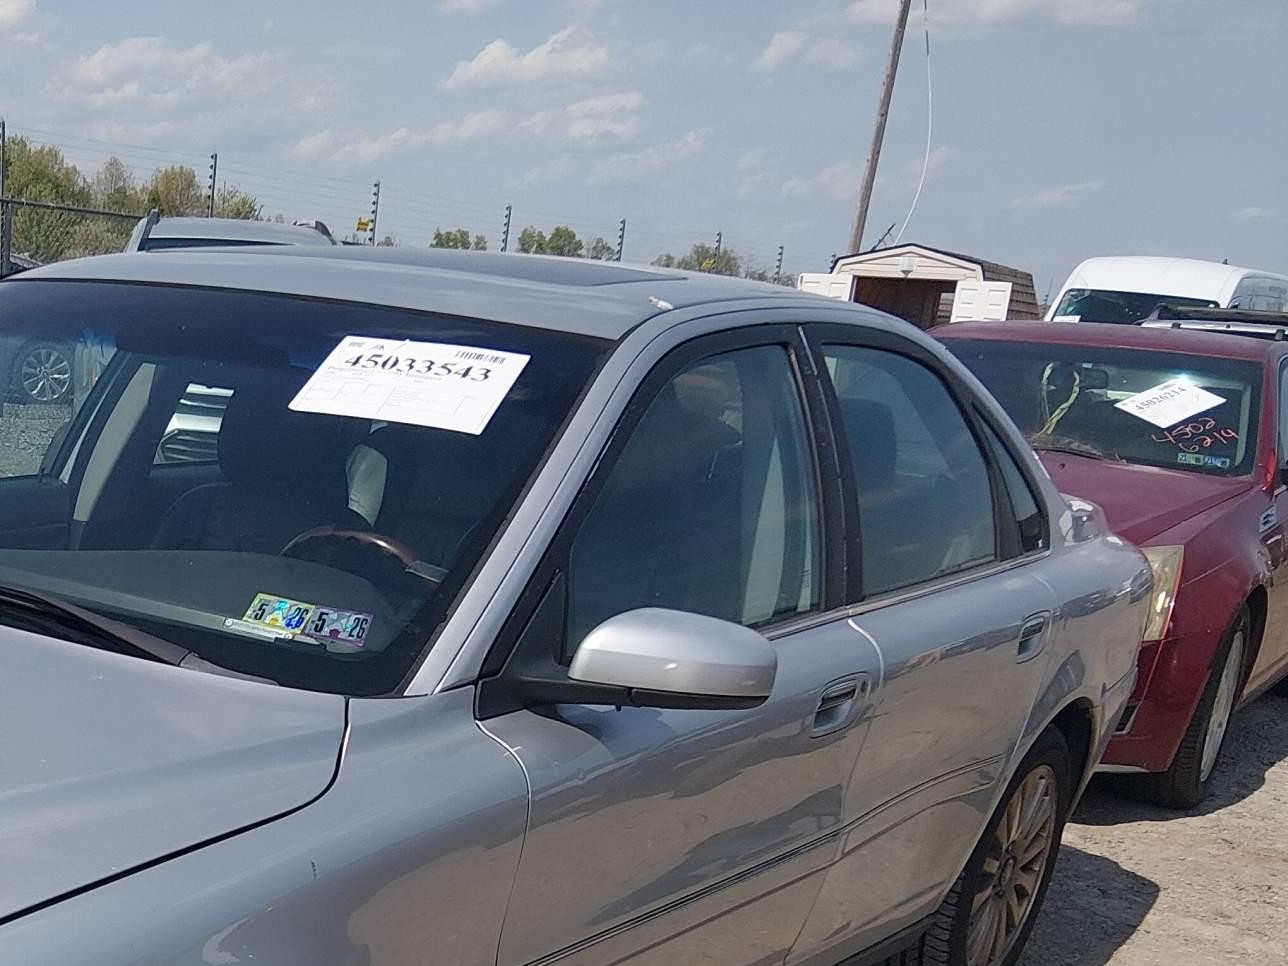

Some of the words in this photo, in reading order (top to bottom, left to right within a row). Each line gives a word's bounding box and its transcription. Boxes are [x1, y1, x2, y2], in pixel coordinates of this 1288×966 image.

[344, 354, 492, 382] 45033543
[1135, 386, 1187, 411] 45026214
[1151, 417, 1217, 444] 4502
[1178, 428, 1240, 453] 6214
[348, 617, 369, 639] 26
